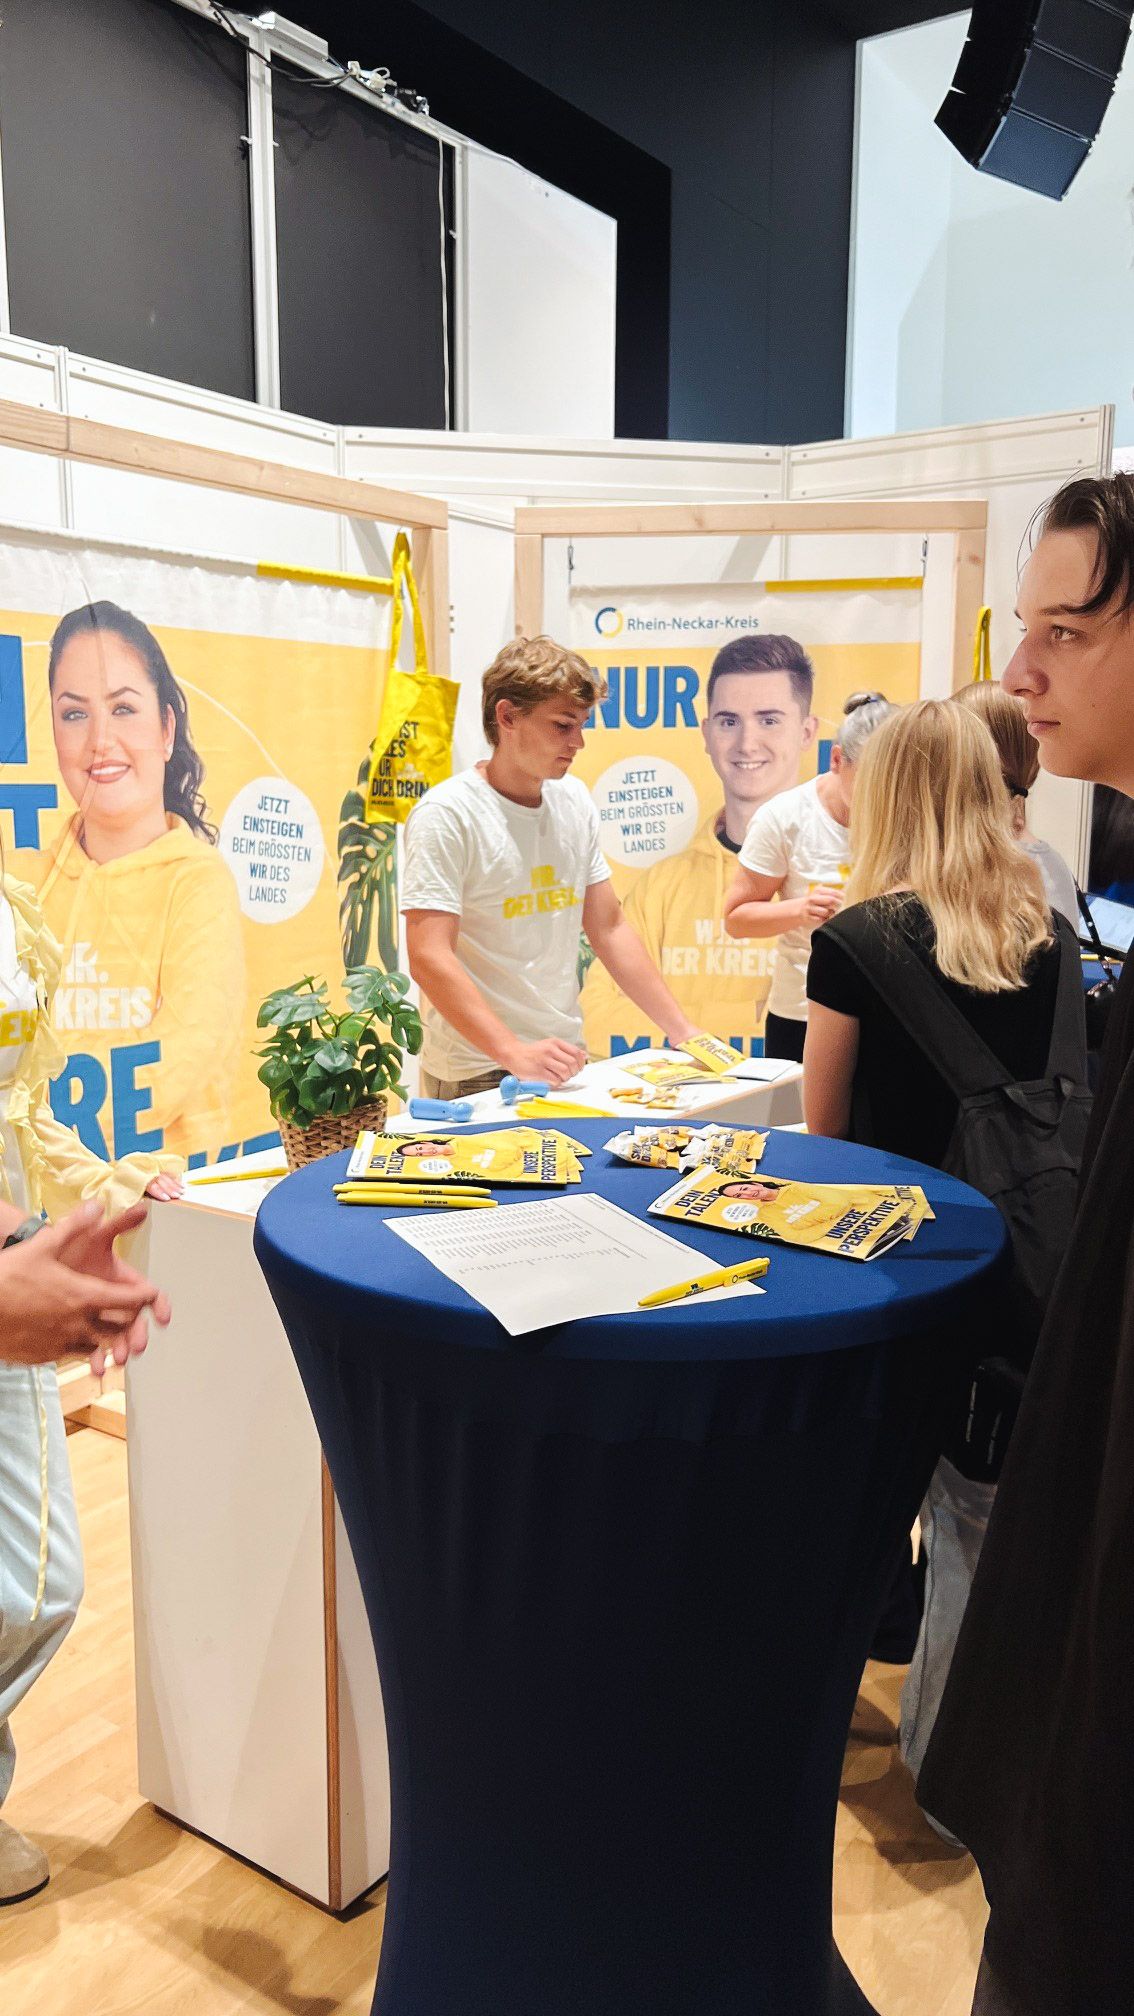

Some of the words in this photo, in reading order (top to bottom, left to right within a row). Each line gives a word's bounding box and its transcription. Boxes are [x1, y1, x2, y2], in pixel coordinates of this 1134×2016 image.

[627, 615, 759, 631] Rhein-Neckar-Kreis
[583, 665, 701, 729] NUR
[622, 769, 656, 785] JETZT
[257, 795, 290, 815] JETZT
[608, 786, 673, 803] EINSTEIGEN
[600, 807, 626, 822] BEIM
[628, 801, 684, 819] GRÖSSTEN
[243, 815, 304, 839] EINSTEIGEN
[620, 823, 642, 836] WIR
[645, 821, 666, 835] DES
[232, 837, 256, 855] BEIM
[258, 838, 312, 862] GRÖSSTEN
[623, 838, 666, 854] LANDES
[249, 862, 268, 879] WIR
[269, 863, 291, 881] DES
[248, 884, 287, 905] LANDES
[54, 986, 153, 1029] KREIS
[674, 1189, 705, 1208] DEIN
[685, 1187, 721, 1217] TALENT
[826, 1208, 868, 1239] UNSERE
[838, 1200, 900, 1253] PERSPEKTIVE
